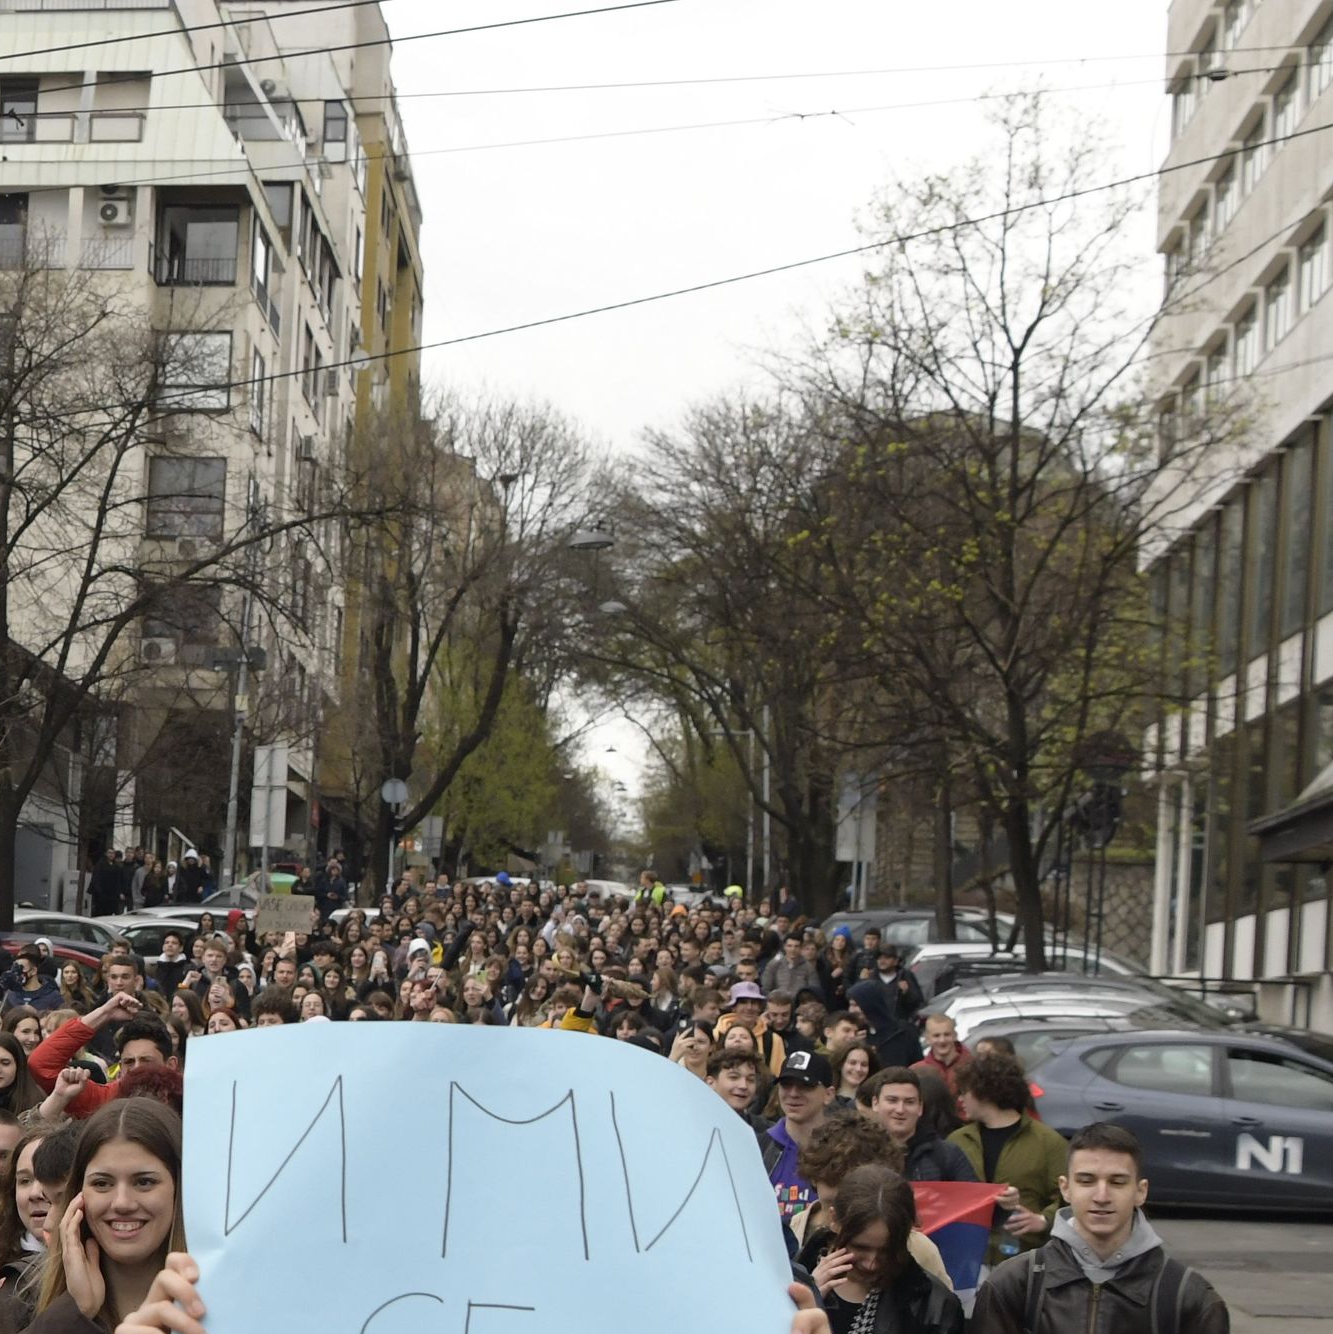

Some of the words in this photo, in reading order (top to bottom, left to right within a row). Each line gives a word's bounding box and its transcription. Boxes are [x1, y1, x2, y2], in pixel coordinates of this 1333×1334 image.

[224, 1073, 347, 1244] И
[441, 1079, 754, 1263] МИ
[1236, 1133, 1304, 1175] N1
